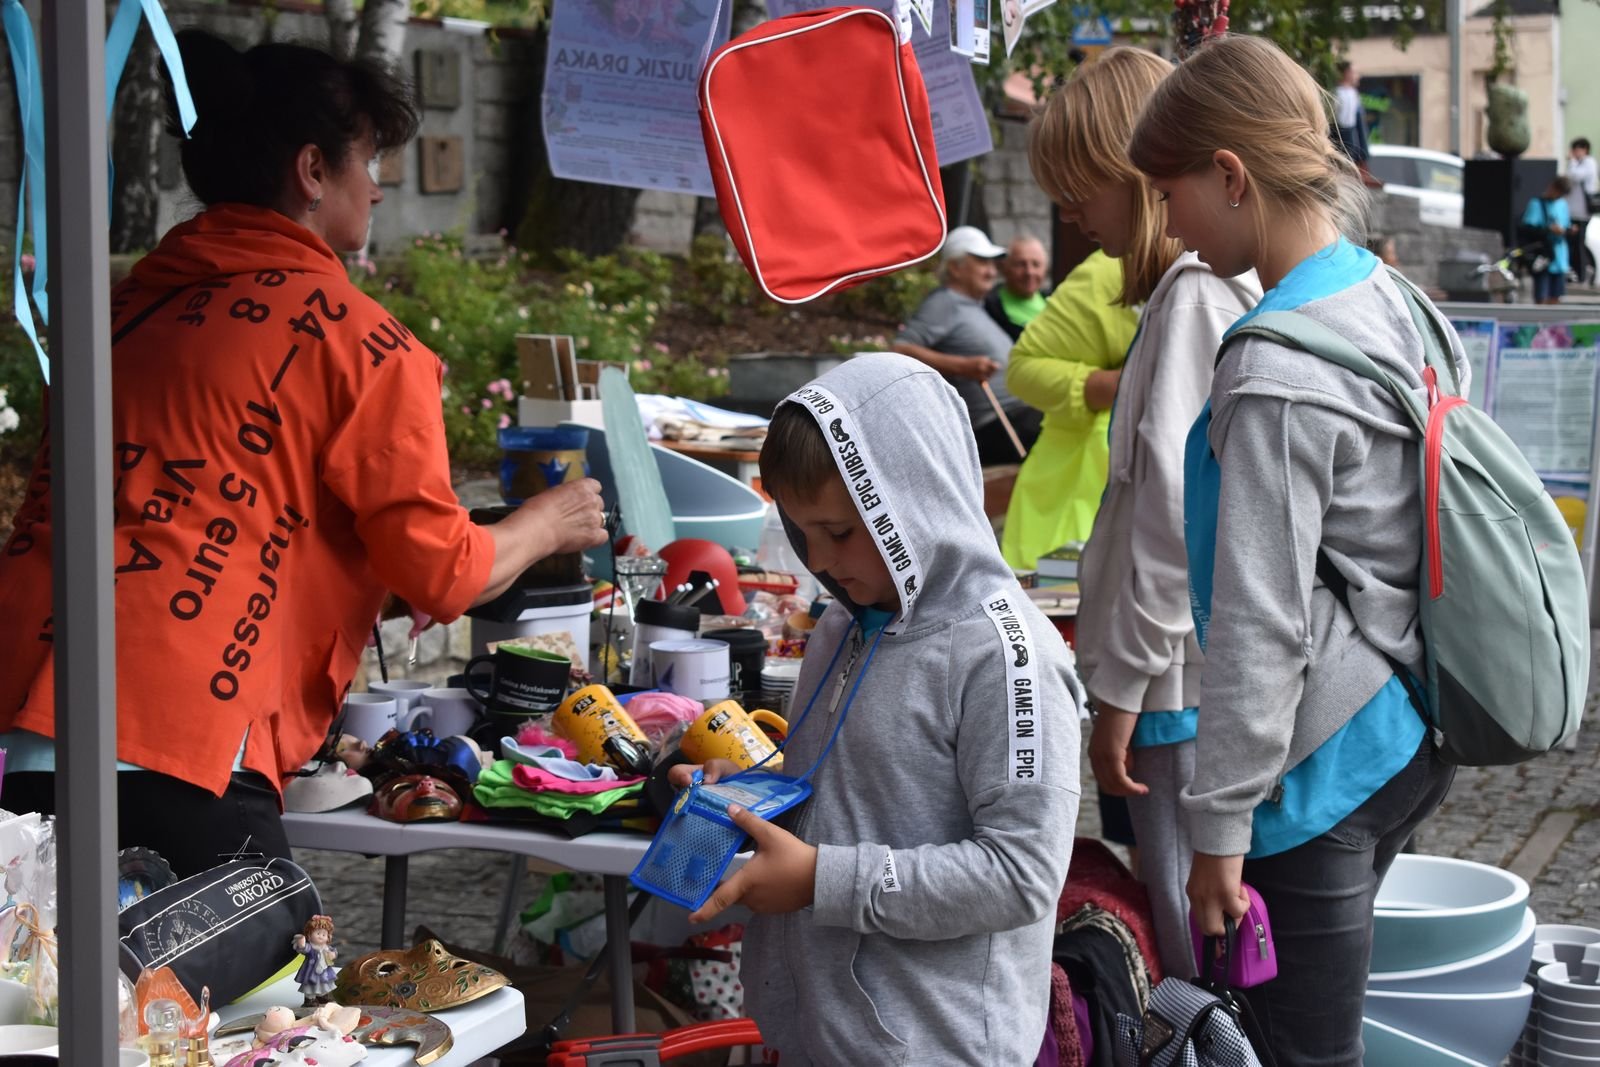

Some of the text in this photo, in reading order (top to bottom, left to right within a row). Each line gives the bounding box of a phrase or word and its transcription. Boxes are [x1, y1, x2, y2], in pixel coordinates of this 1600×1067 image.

[229, 297, 271, 324] 8
[287, 287, 348, 342] 24
[237, 398, 283, 456] 10
[837, 440, 868, 482] VIBES
[139, 458, 207, 525] Via
[218, 472, 258, 508] 5
[855, 477, 882, 512] EPIC
[872, 512, 895, 537] ON
[168, 516, 238, 621] euro
[882, 531, 912, 572] GAME
[209, 503, 310, 702] ingresso
[999, 612, 1026, 643] VIBES
[1013, 678, 1035, 779] GAME ON EPIC
[224, 871, 264, 896] UNIVERSITY
[232, 874, 284, 908] OXFORD
[883, 877, 897, 889] ON
